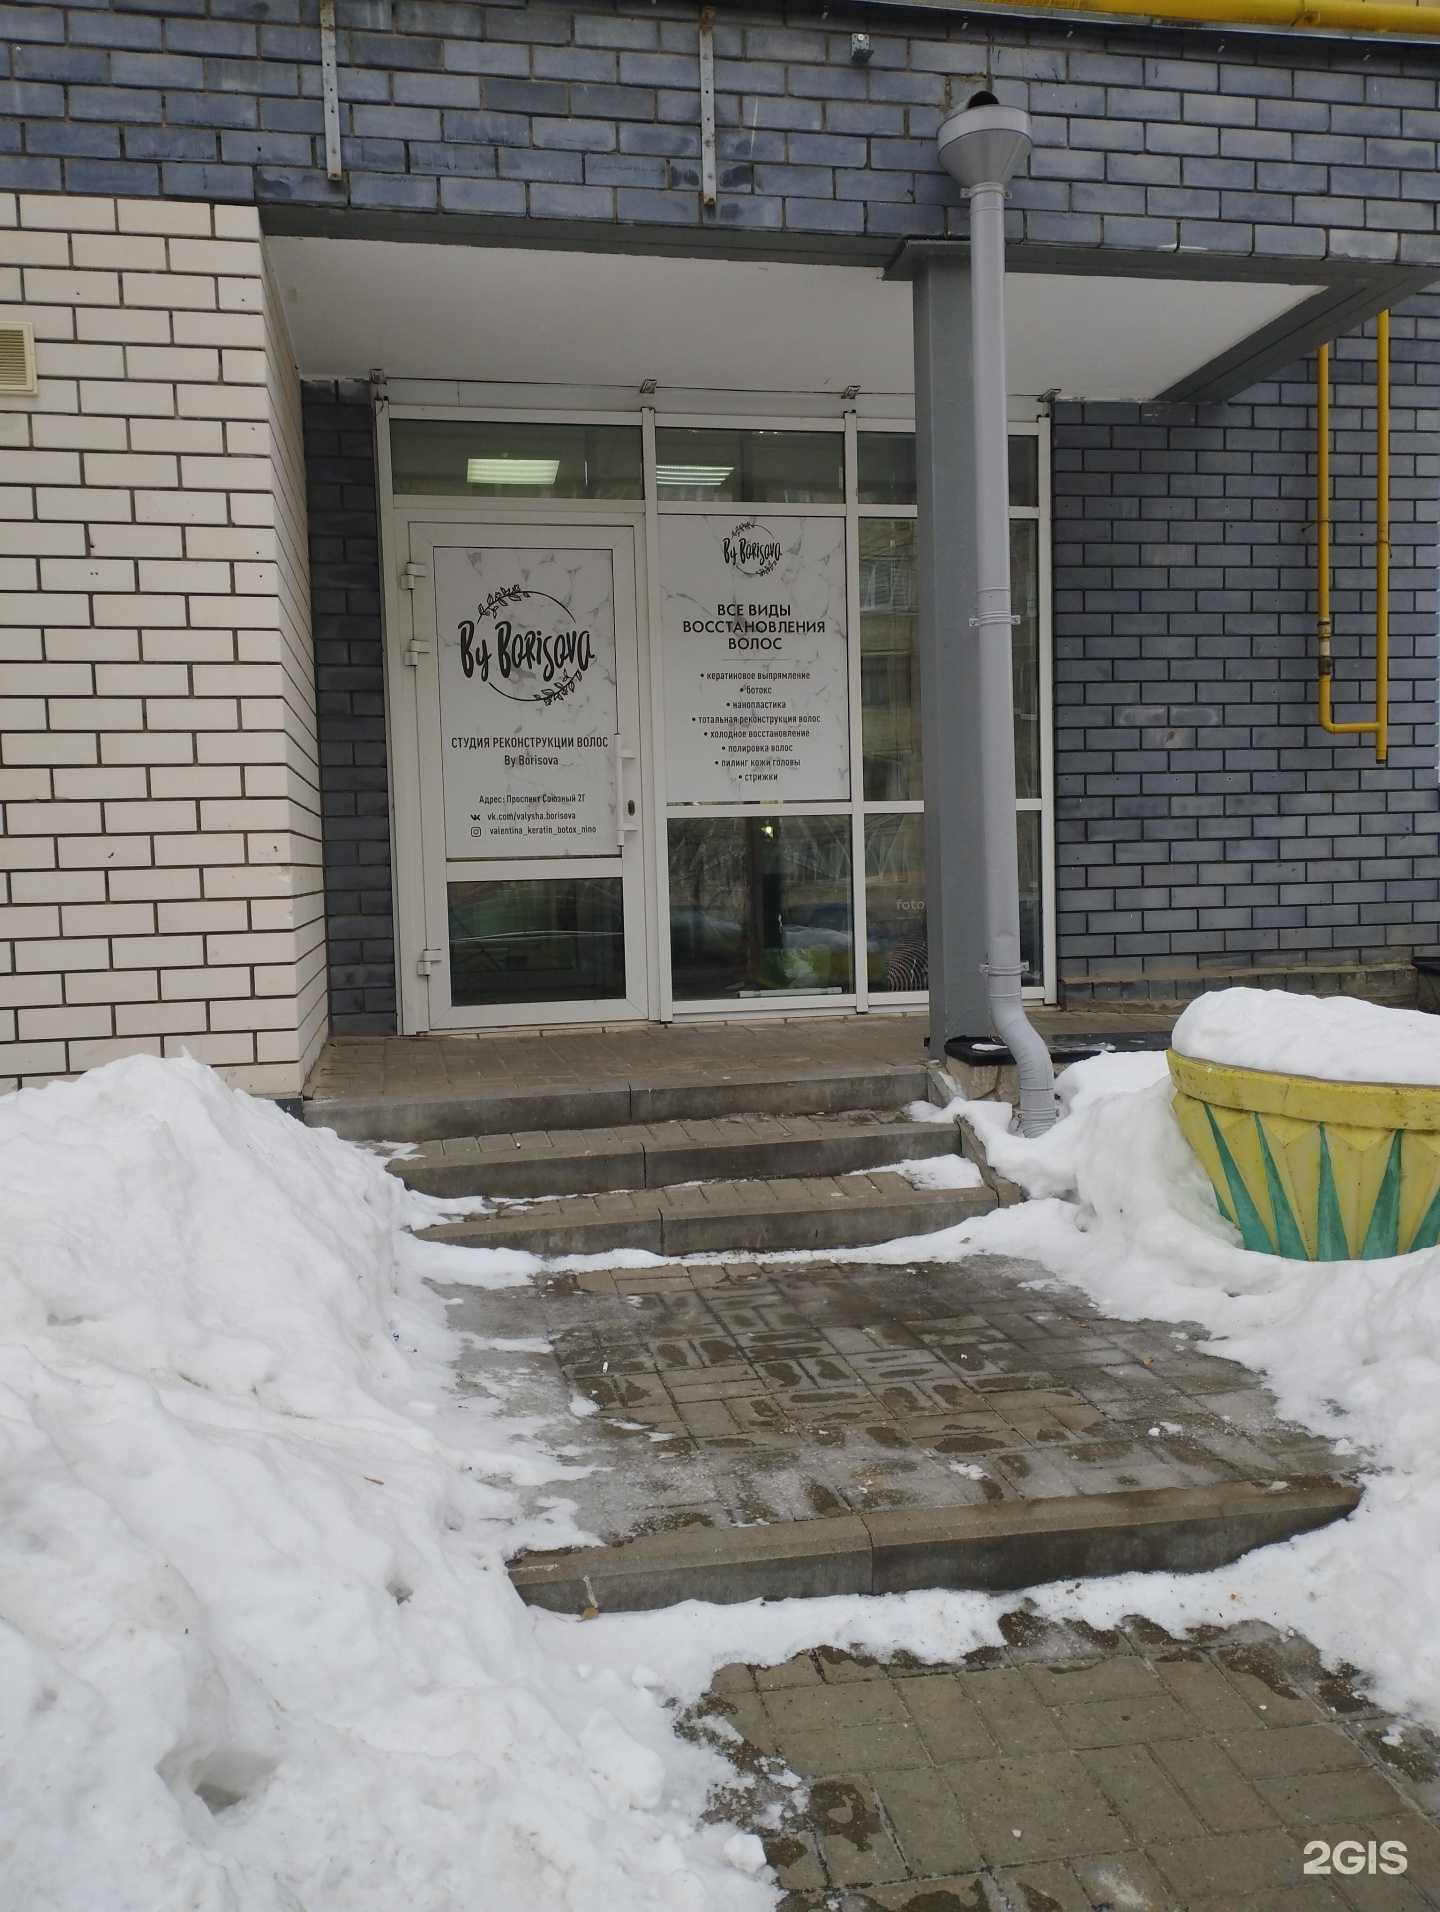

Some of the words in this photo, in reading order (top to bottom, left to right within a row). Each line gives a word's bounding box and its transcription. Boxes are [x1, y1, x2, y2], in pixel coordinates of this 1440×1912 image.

[721, 537, 738, 566] By
[717, 603, 744, 616] ВСЕ
[748, 603, 791, 618] ВИДЫ
[683, 620, 825, 633] ВОССТАНОВЛЕНИЯ
[728, 637, 783, 650] ВОЛОС
[458, 620, 492, 682] By
[706, 671, 756, 682] кератиновое
[757, 671, 811, 681] выпрямление
[746, 685, 772, 695] ботокс
[733, 700, 787, 710] нанопластика
[698, 715, 738, 725] тотальная
[739, 715, 797, 726] реконструкция
[798, 714, 821, 724] волос
[710, 730, 747, 740] холодное
[748, 729, 810, 739] восстановление
[451, 737, 490, 750] СТУДИЯ
[493, 736, 574, 749] РЕКОНСТРУКЦИИ
[577, 736, 608, 748] ВОЛОС
[728, 744, 769, 754] полировка
[770, 743, 793, 753] волос
[504, 754, 517, 767] By
[518, 754, 559, 766] Borisova
[721, 759, 747, 768] пилинг
[750, 759, 771, 768] кожи
[772, 758, 801, 768] головы
[744, 773, 778, 783] стрижки
[479, 794, 506, 804] Адрес:
[506, 793, 541, 804] Проспект
[542, 792, 576, 803] Союзный
[487, 811, 576, 822] vk.com/valysha.borisova
[489, 824, 598, 836] valentina_keratin_botox_nino
